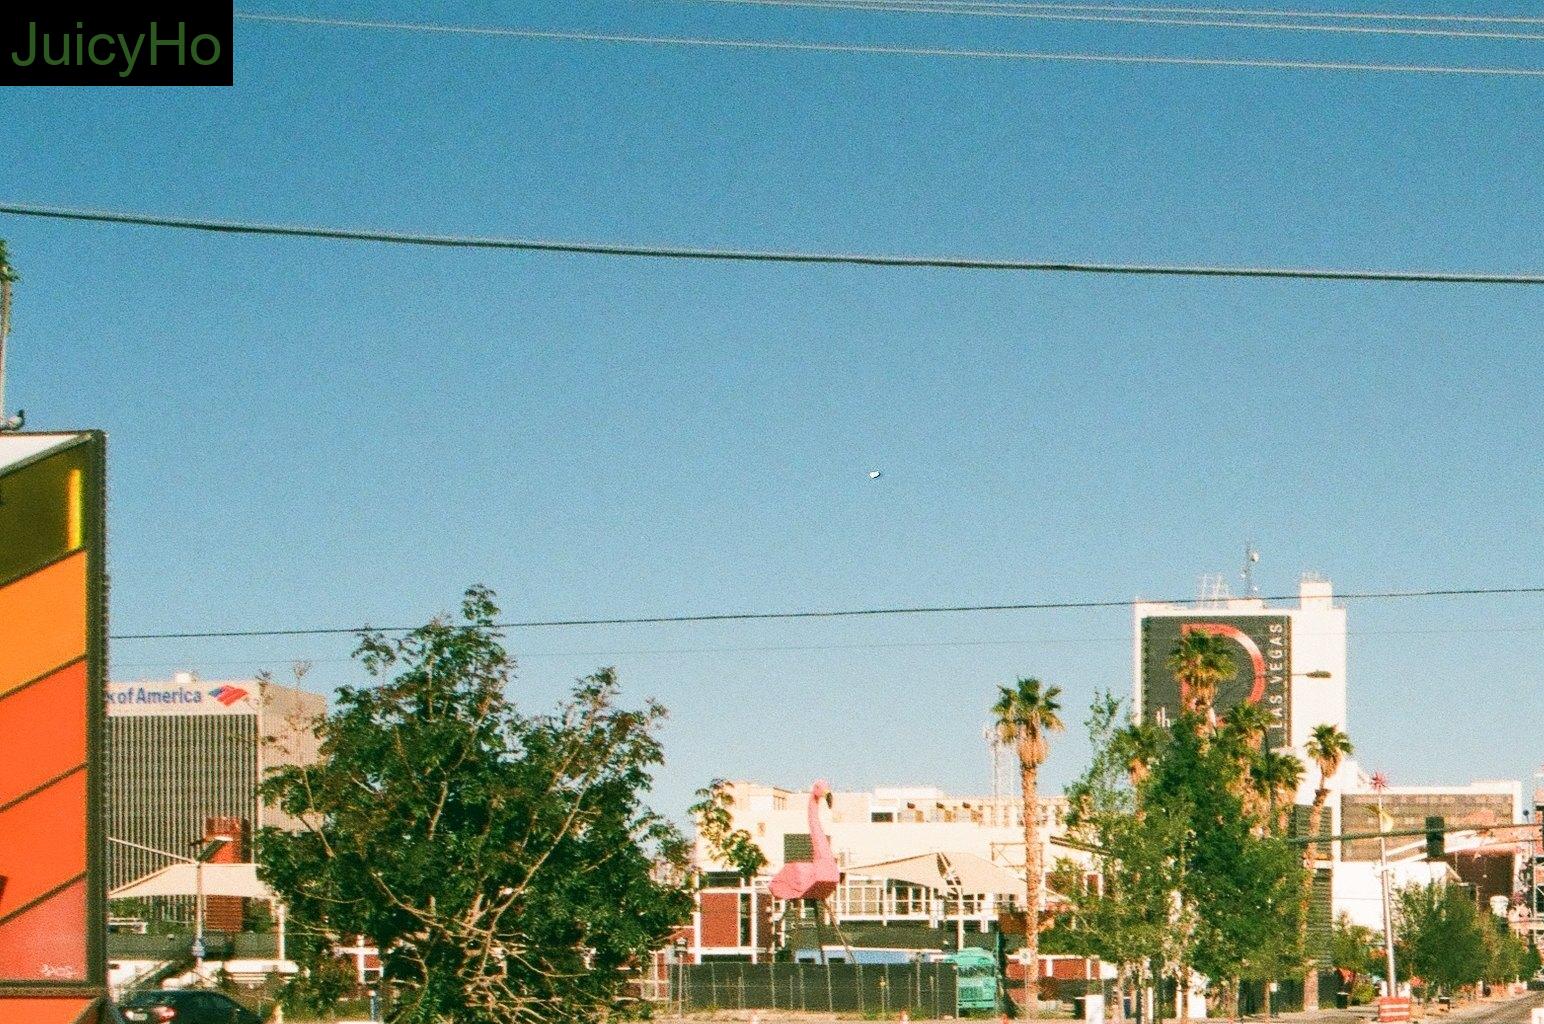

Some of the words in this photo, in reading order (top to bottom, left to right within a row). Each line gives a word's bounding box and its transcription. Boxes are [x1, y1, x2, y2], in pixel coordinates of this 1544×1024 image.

[1270, 623, 1284, 686] VEGAS
[117, 686, 134, 704] of
[137, 687, 202, 704] America
[1270, 694, 1284, 729] LAS
